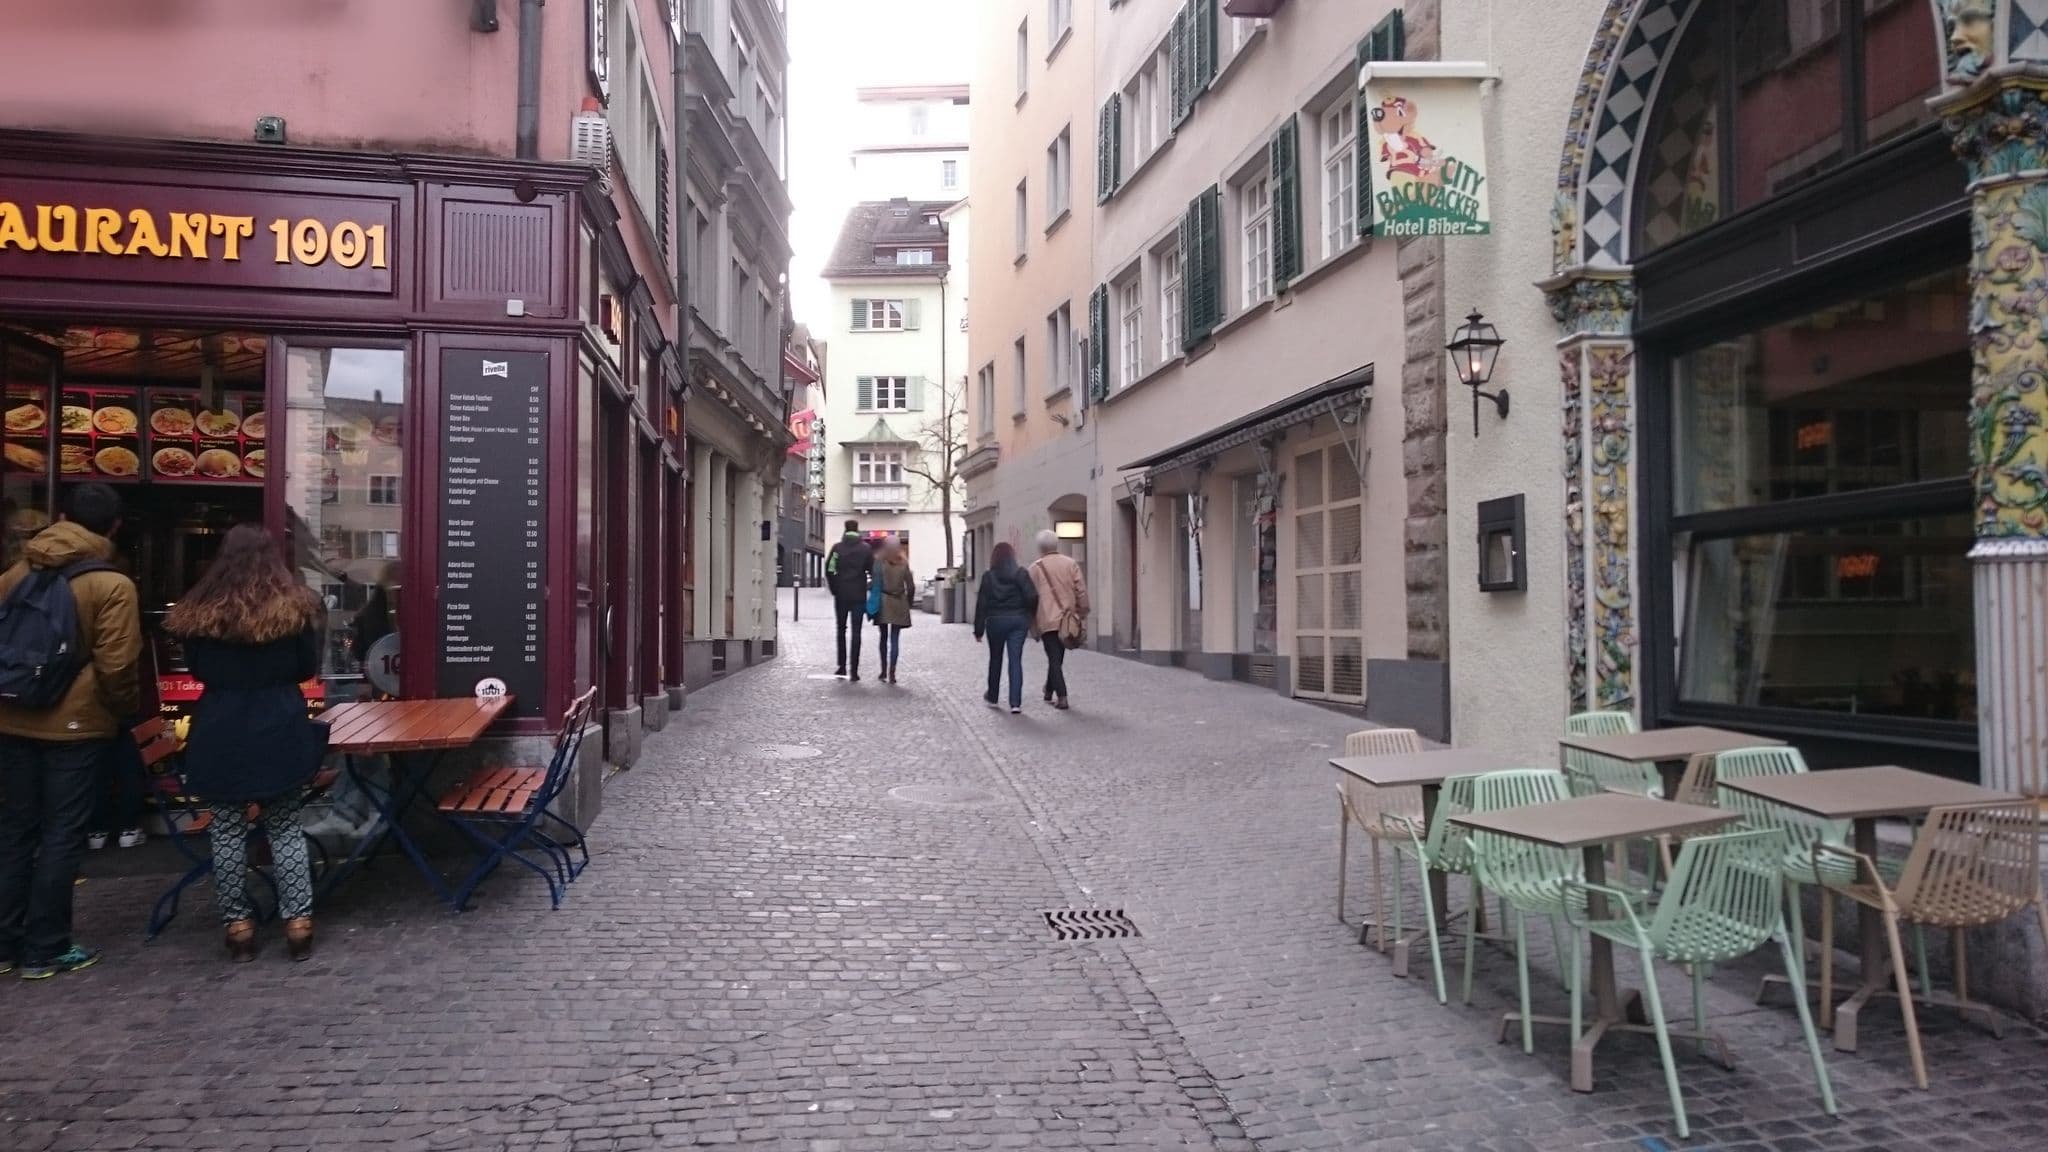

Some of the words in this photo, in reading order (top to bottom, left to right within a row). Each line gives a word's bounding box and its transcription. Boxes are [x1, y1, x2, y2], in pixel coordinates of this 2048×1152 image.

[1440, 156, 1485, 196] CITY
[1376, 181, 1480, 220] BACKPACKER
[0, 202, 254, 261] AURANT
[269, 218, 387, 269] 1001
[1384, 218, 1424, 236] Hotel
[1428, 217, 1467, 235] Biber
[485, 365, 505, 374] rivella
[810, 420, 821, 498] CINEMA
[176, 680, 205, 691] Take
